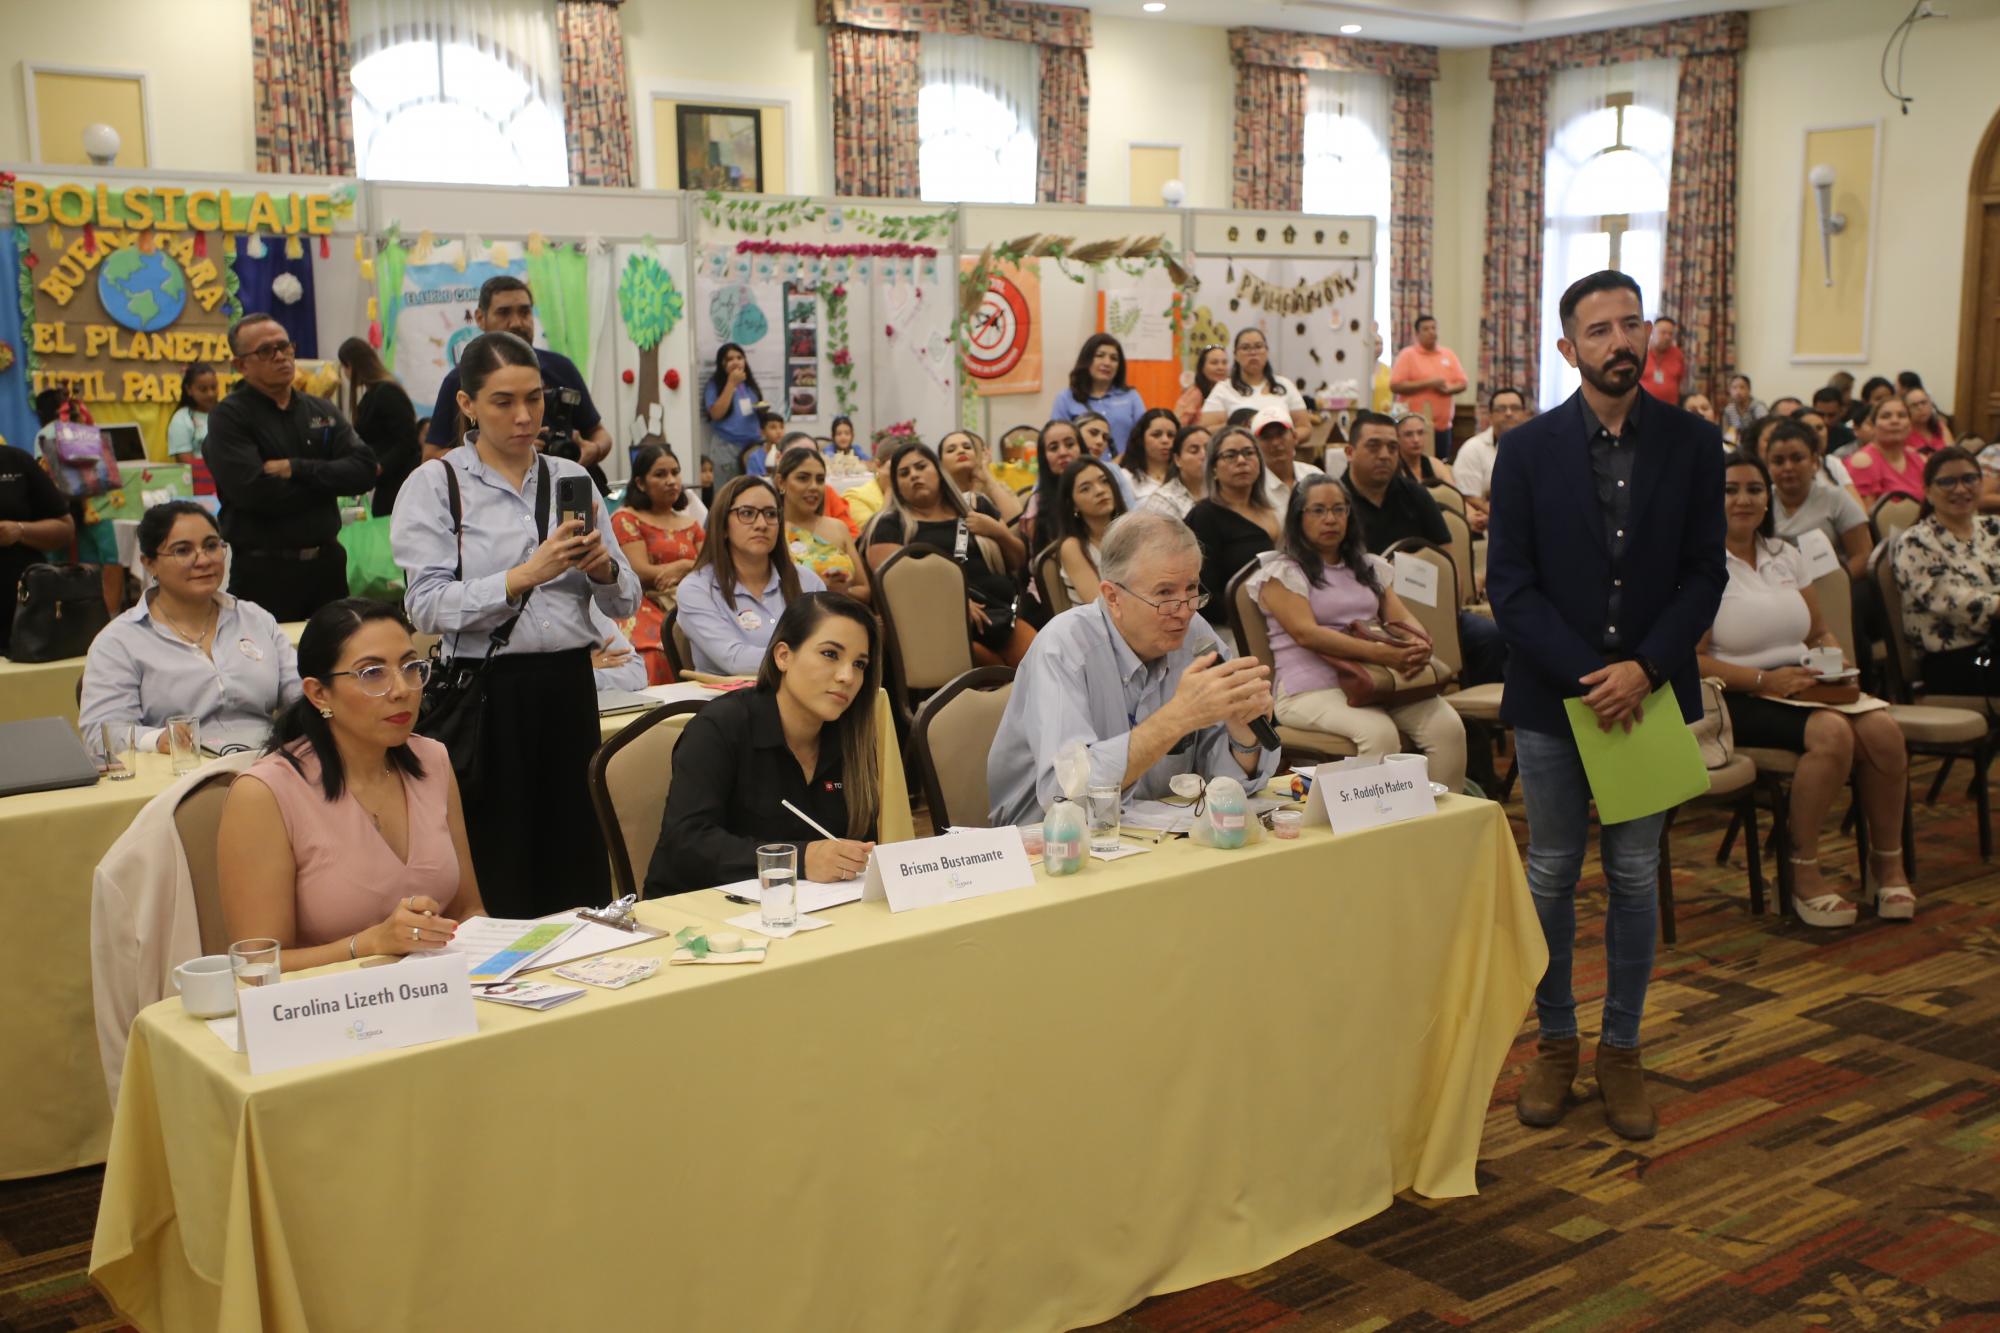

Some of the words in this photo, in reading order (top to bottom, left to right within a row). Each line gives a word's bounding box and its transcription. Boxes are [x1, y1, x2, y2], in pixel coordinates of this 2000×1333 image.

[14, 181, 332, 235] BOLSICLAJE
[32, 322, 77, 354] EL
[85, 325, 234, 362] PLANETA
[1339, 790, 1353, 802] Sr.
[1353, 784, 1384, 800] Rodolfo
[1385, 780, 1414, 793] Madero
[900, 861, 939, 877] Brisma
[940, 850, 1004, 870] Bustamante
[273, 998, 340, 1022] Carolina
[344, 987, 395, 1010] Lizeth
[399, 981, 449, 1001] Osuna
